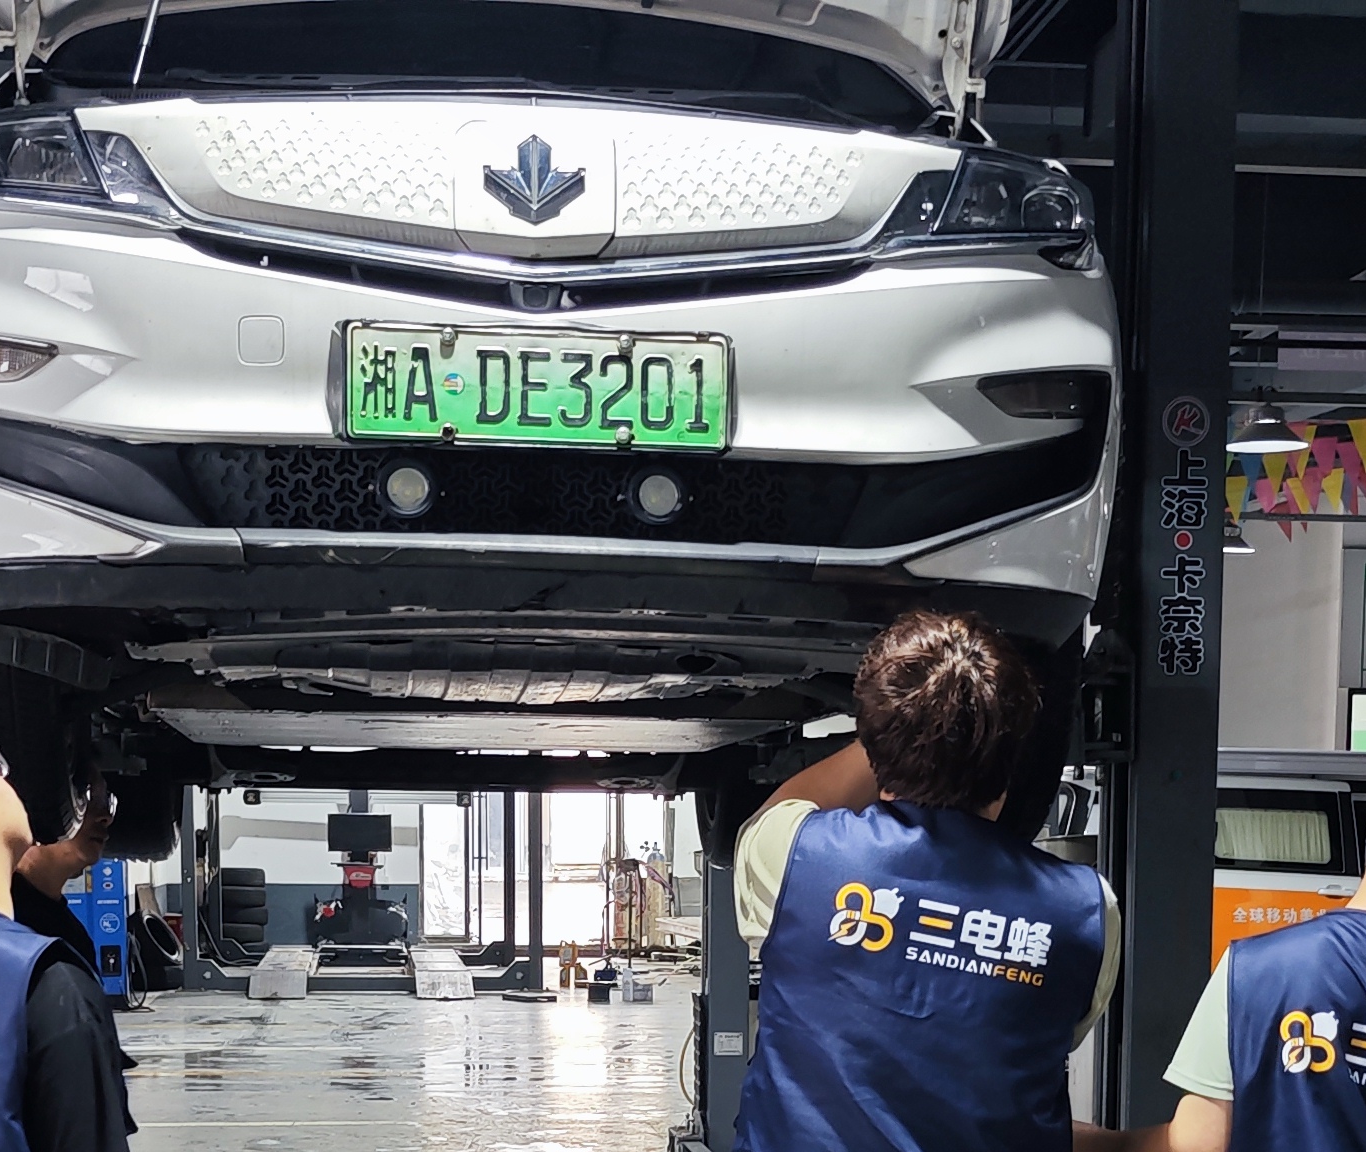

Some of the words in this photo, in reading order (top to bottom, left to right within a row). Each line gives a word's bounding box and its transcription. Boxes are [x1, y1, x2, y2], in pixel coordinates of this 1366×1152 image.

[476, 347, 710, 433] DE3201
[905, 947, 1045, 987] SANDIANFENG
[909, 898, 1052, 968] 三电蜂
